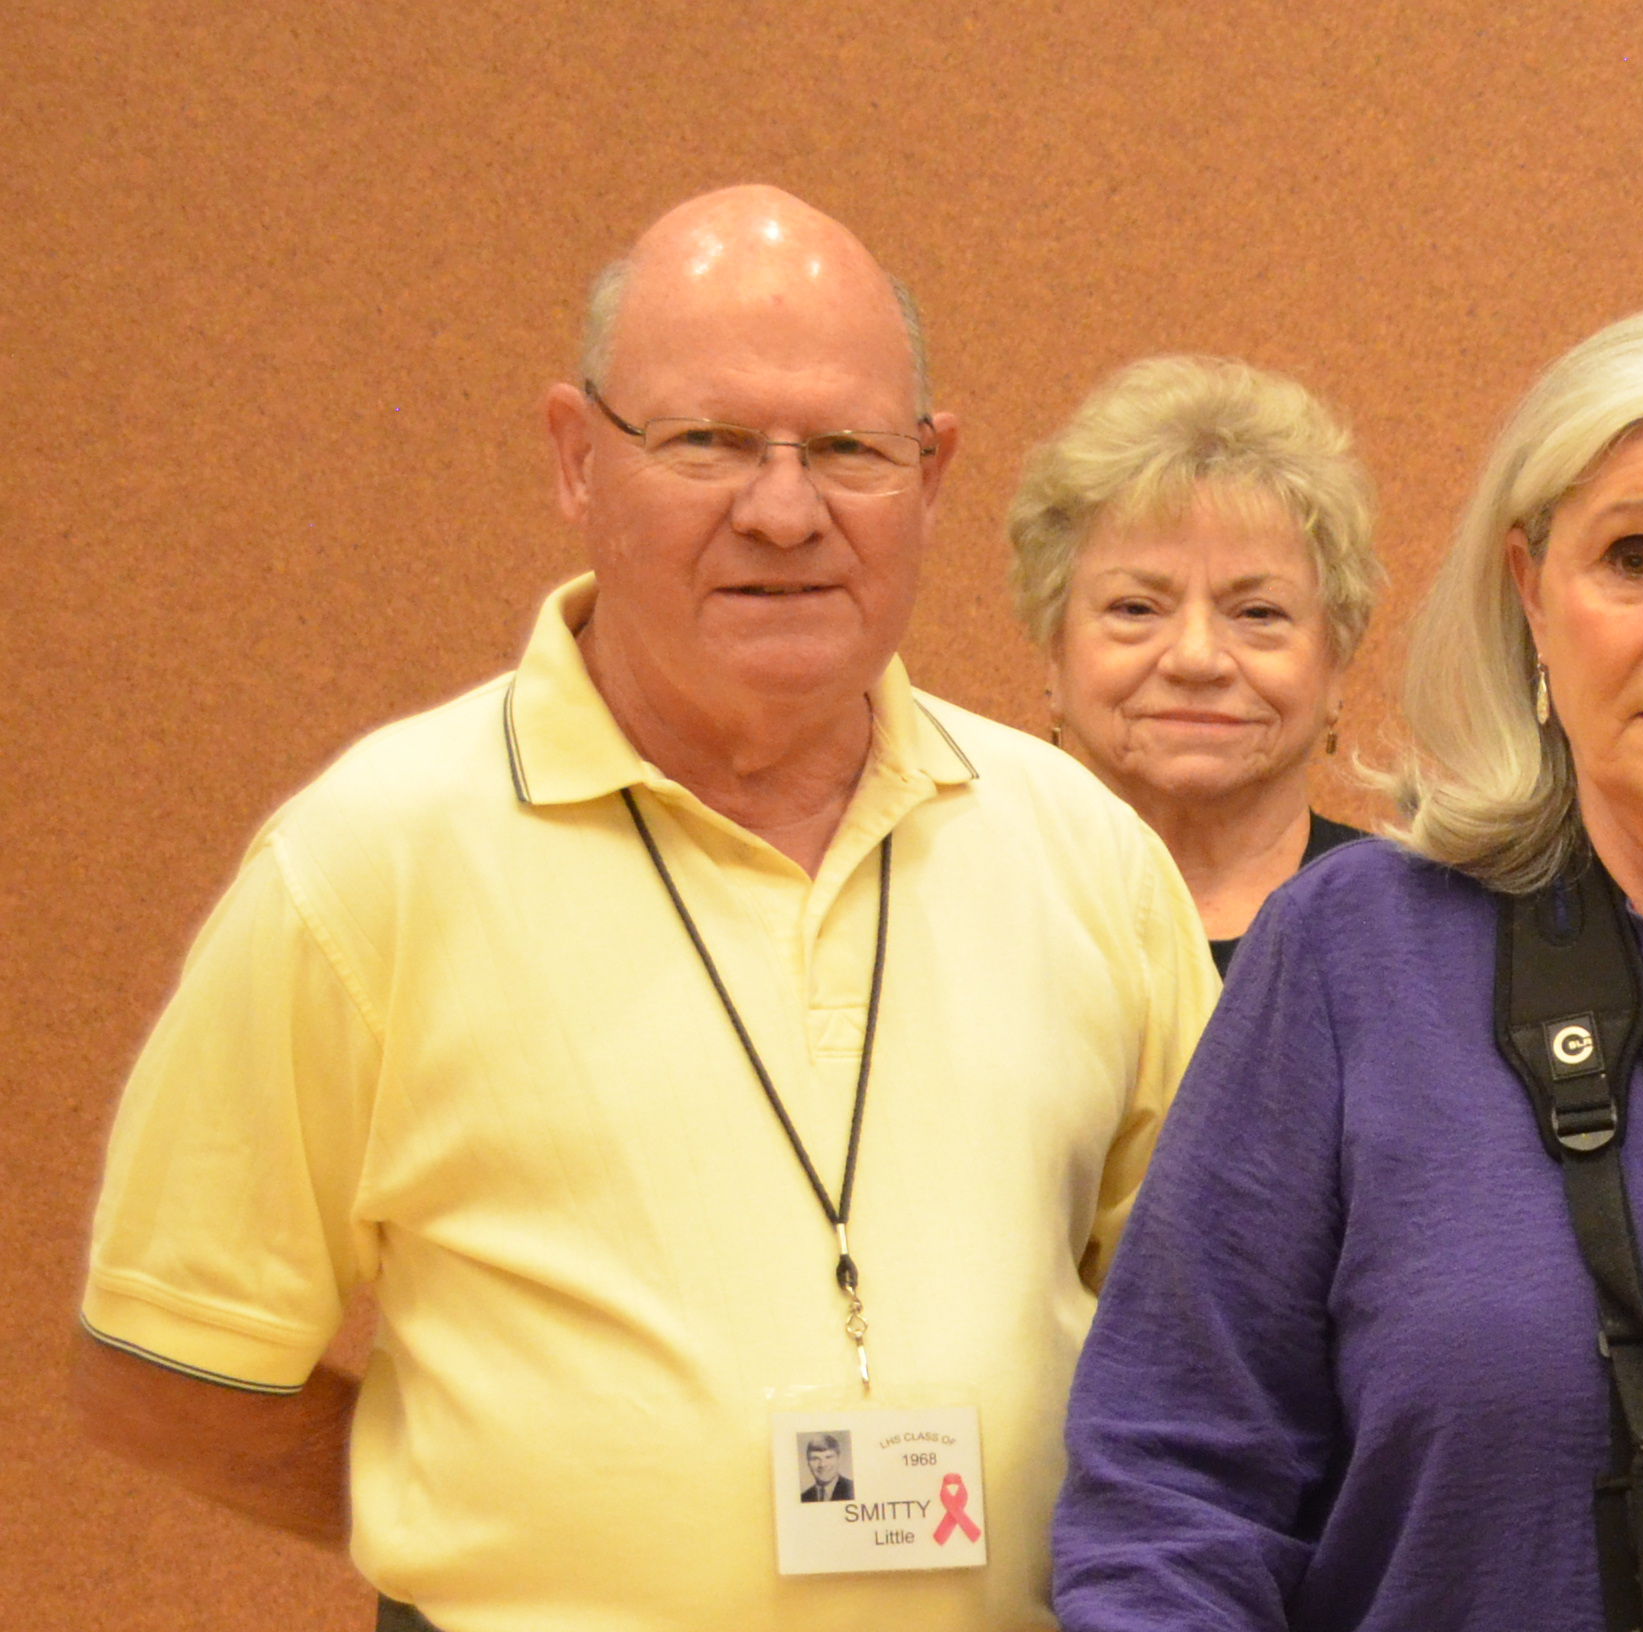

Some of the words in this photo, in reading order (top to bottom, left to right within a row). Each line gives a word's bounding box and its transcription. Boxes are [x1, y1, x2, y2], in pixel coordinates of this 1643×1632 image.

[879, 1435, 901, 1449] LHS
[904, 1432, 939, 1443] CLASS
[941, 1435, 956, 1446] OF
[902, 1453, 937, 1467] 1968
[844, 1500, 931, 1523] SMITTY
[874, 1530, 915, 1546] Little
